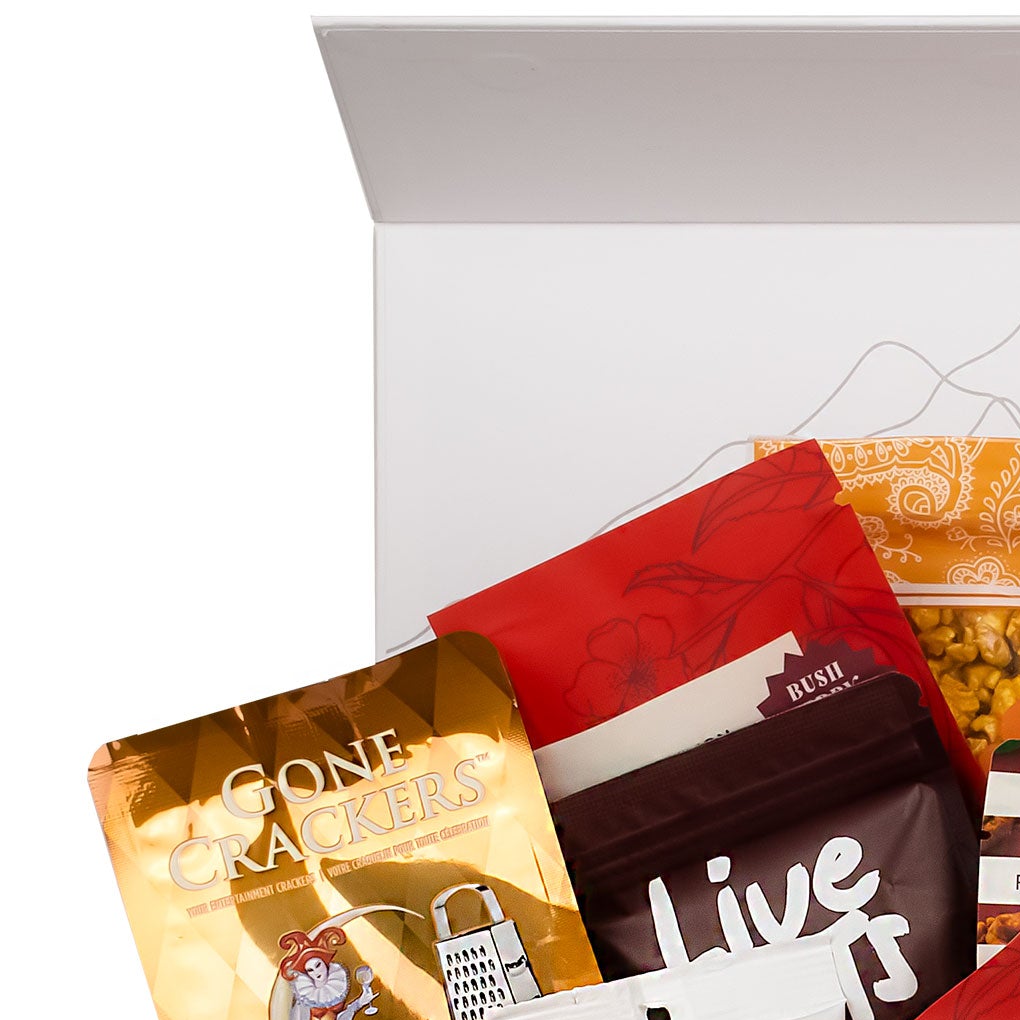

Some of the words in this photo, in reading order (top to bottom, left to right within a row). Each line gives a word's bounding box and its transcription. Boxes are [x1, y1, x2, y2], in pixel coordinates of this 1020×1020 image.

[785, 660, 844, 702] BUSH
[221, 728, 409, 818] GONE
[328, 861, 351, 877] VOTRE
[210, 884, 275, 912] ENTERTAINMENT
[276, 872, 317, 893] CRACKERS
[648, 836, 881, 969] Live
